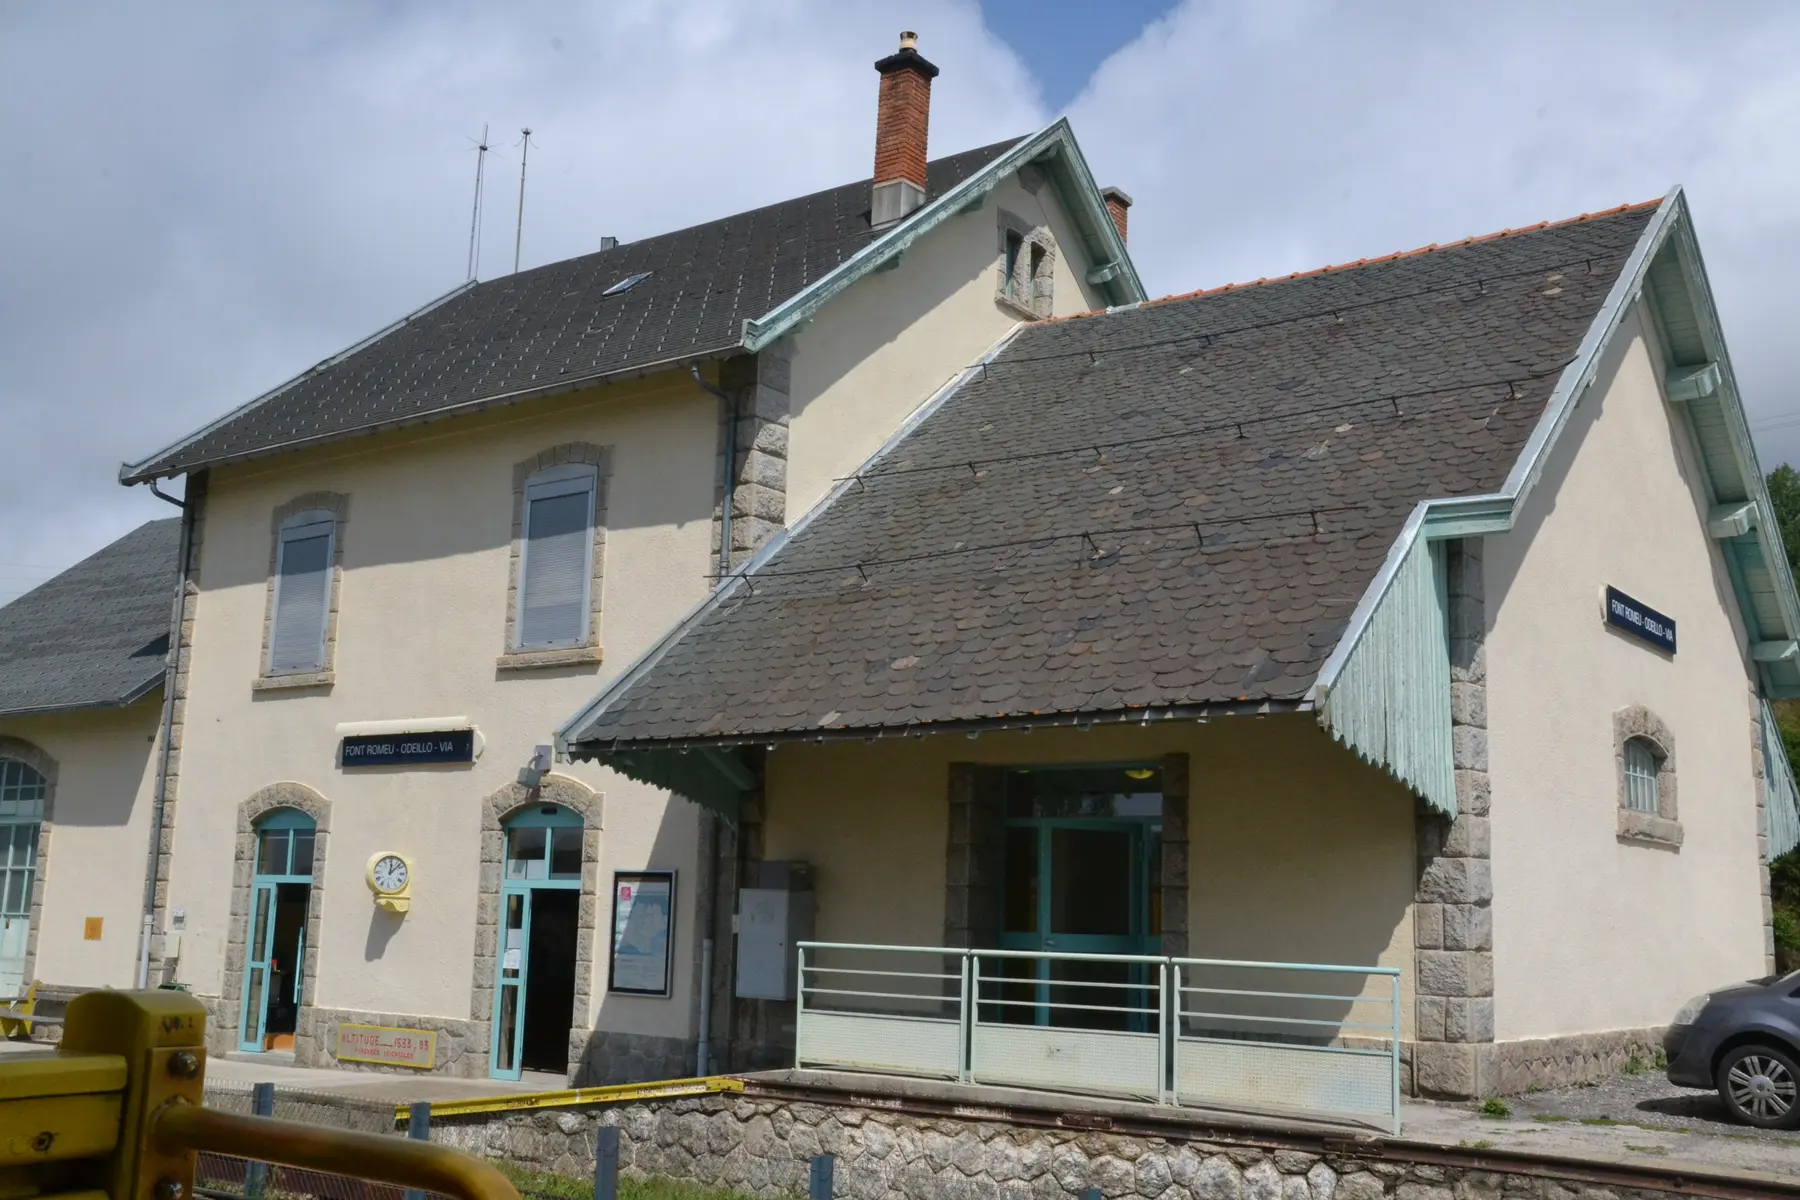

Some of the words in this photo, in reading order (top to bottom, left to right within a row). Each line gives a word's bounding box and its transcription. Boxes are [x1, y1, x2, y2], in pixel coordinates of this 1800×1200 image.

[1611, 599, 1625, 617] FONT
[1625, 606, 1642, 626] ROMEU
[1665, 627, 1674, 643] VIA
[345, 745, 365, 756] FONT
[366, 744, 394, 755] ROMEU
[400, 742, 433, 754] ODEILLO
[439, 741, 453, 752] VIA
[342, 1033, 380, 1046] ALTITUDE
